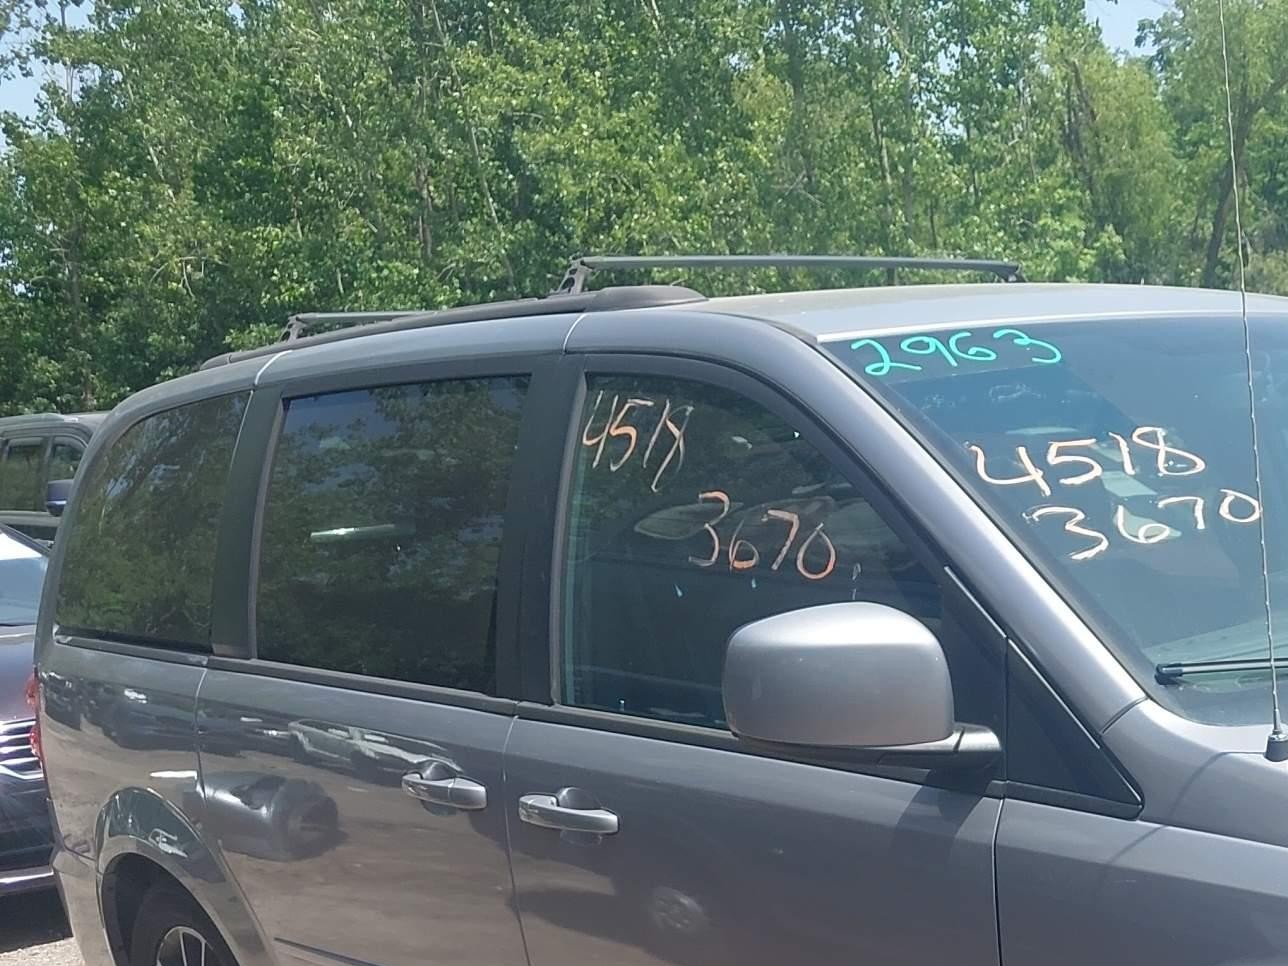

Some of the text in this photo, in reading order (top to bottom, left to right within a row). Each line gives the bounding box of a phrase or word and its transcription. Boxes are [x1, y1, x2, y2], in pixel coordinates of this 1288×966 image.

[850, 327, 1063, 376] 2963
[583, 389, 694, 493] 4518
[965, 426, 1206, 497] 4518
[688, 489, 837, 580] 3670
[1025, 488, 1264, 561] 3670
